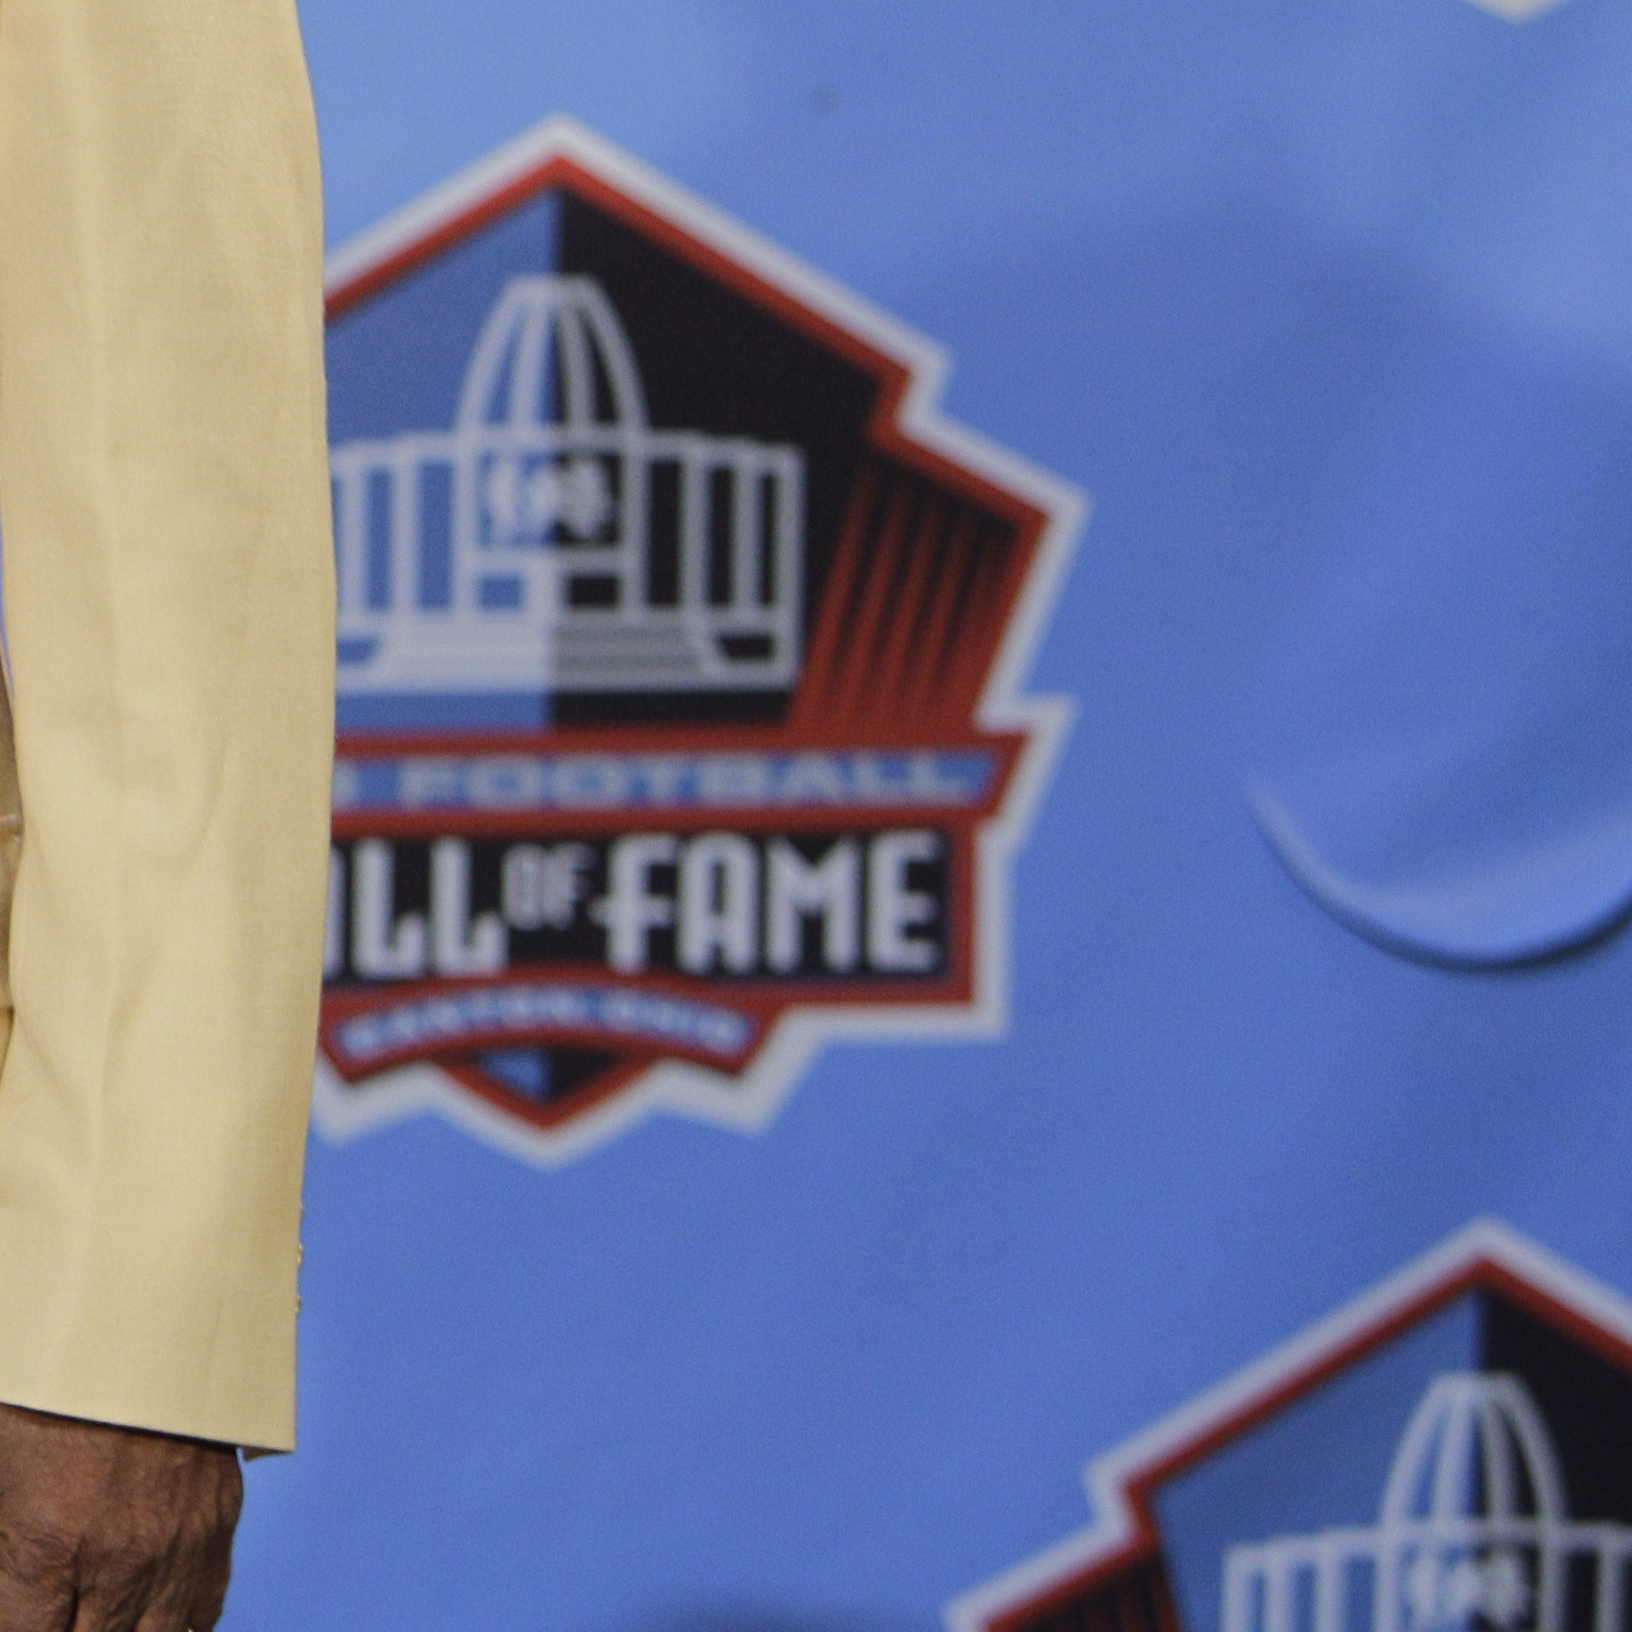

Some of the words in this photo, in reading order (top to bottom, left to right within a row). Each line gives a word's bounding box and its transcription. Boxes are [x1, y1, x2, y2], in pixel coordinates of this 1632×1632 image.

[324, 837, 507, 979] LL
[504, 844, 592, 929] OF
[591, 830, 943, 974] FAME
